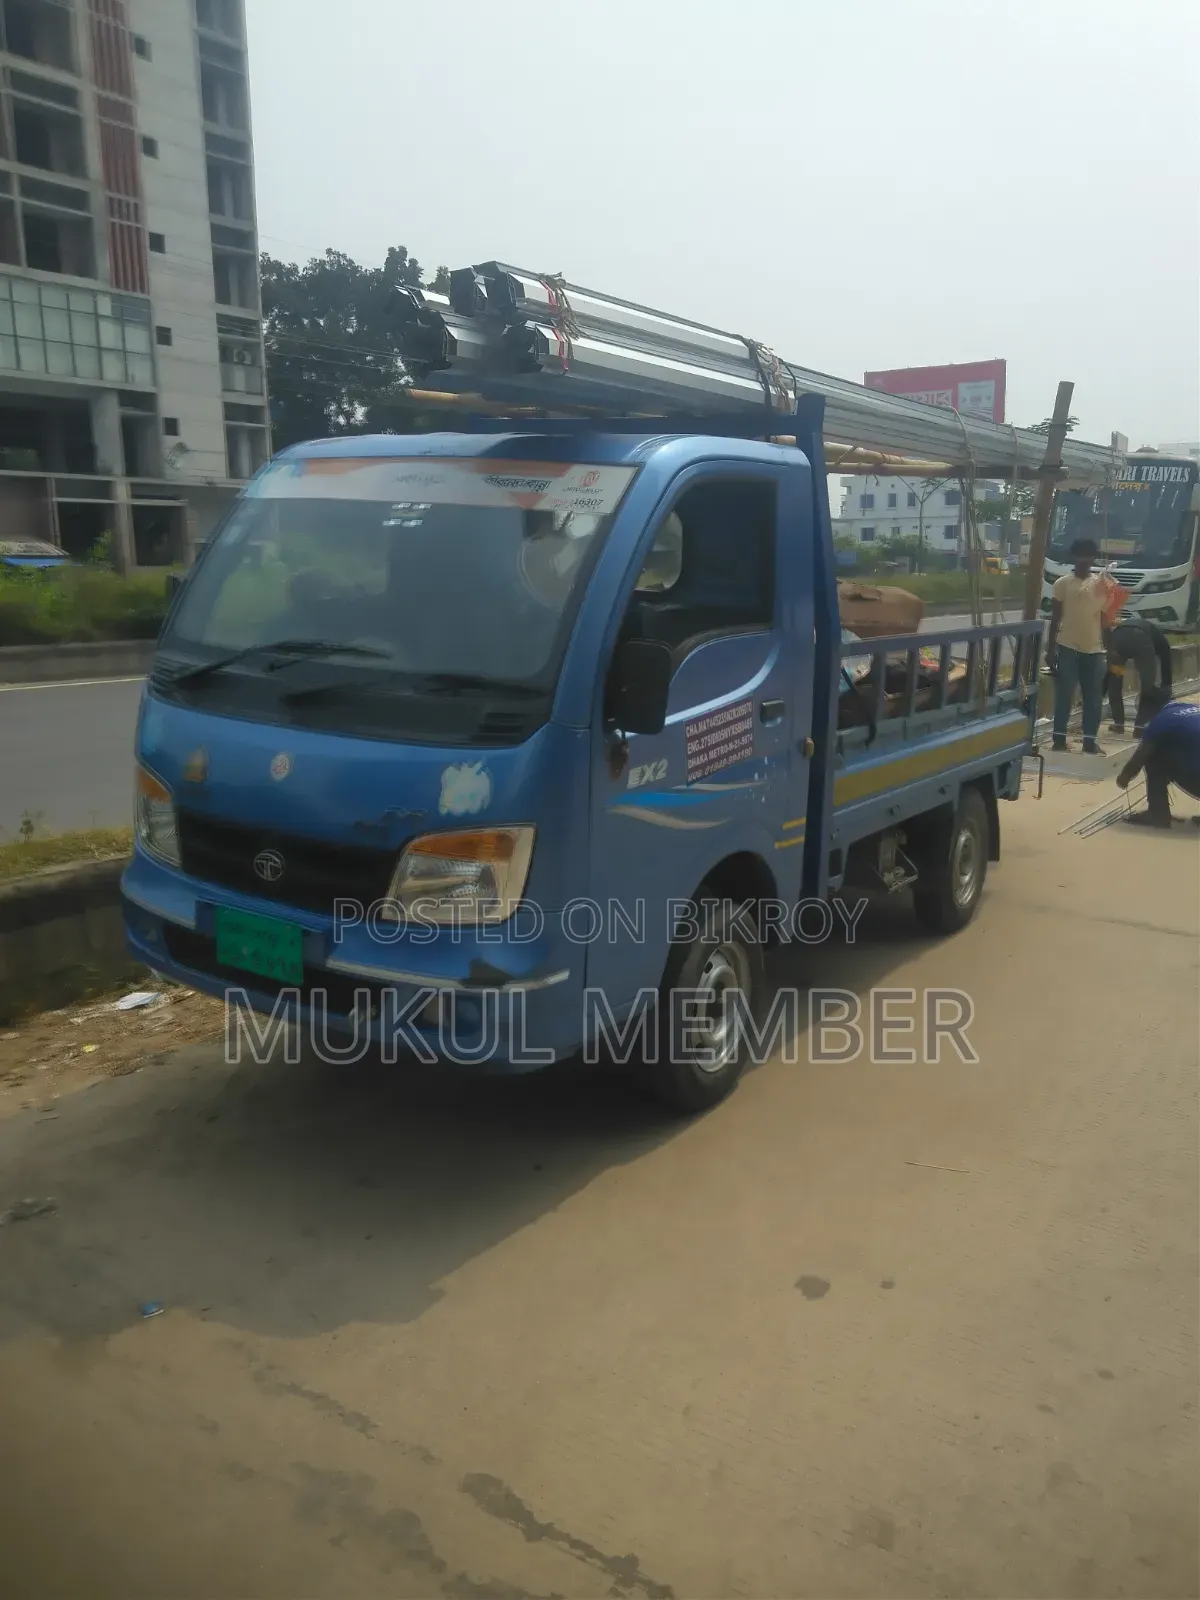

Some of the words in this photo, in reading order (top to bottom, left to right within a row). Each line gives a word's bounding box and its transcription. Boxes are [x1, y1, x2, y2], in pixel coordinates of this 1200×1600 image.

[1141, 465, 1191, 483] TRAVELS
[572, 497, 605, 507] 16307
[627, 759, 668, 790] EX2
